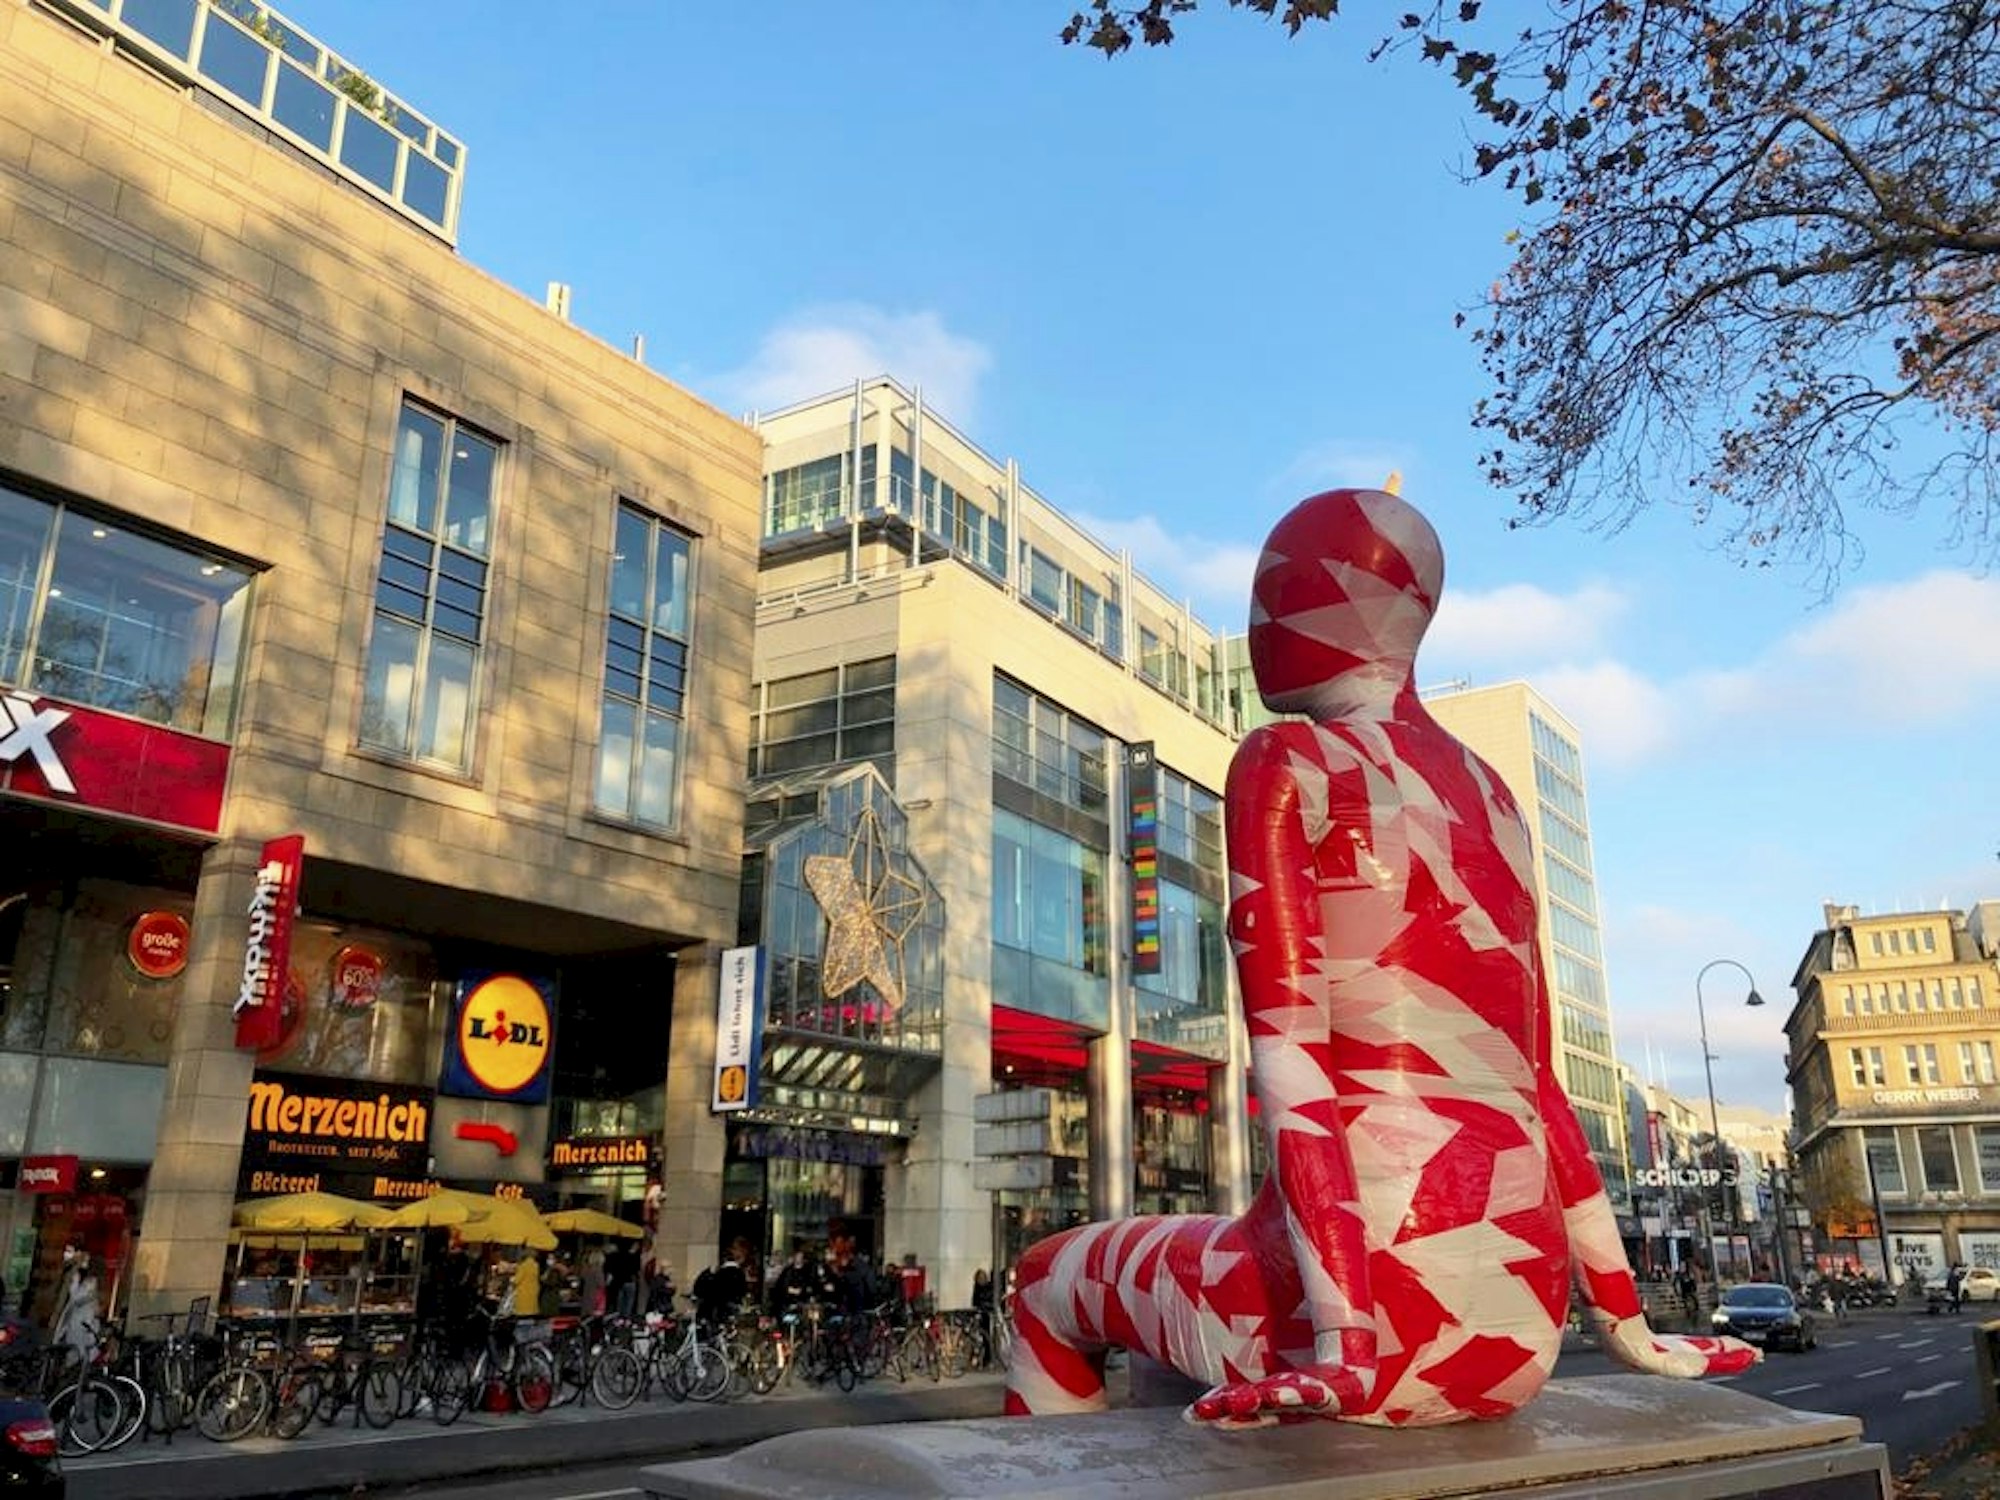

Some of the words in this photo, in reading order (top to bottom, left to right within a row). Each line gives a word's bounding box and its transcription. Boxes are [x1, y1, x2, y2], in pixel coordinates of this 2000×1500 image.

[142, 932, 180, 949] große
[1923, 1087, 1980, 1103] WEBER
[250, 1081, 427, 1142] Merzenich
[554, 1139, 648, 1164] Merzenich
[252, 1170, 319, 1193] Bäckerei
[1894, 1255, 1933, 1266] GUYS
